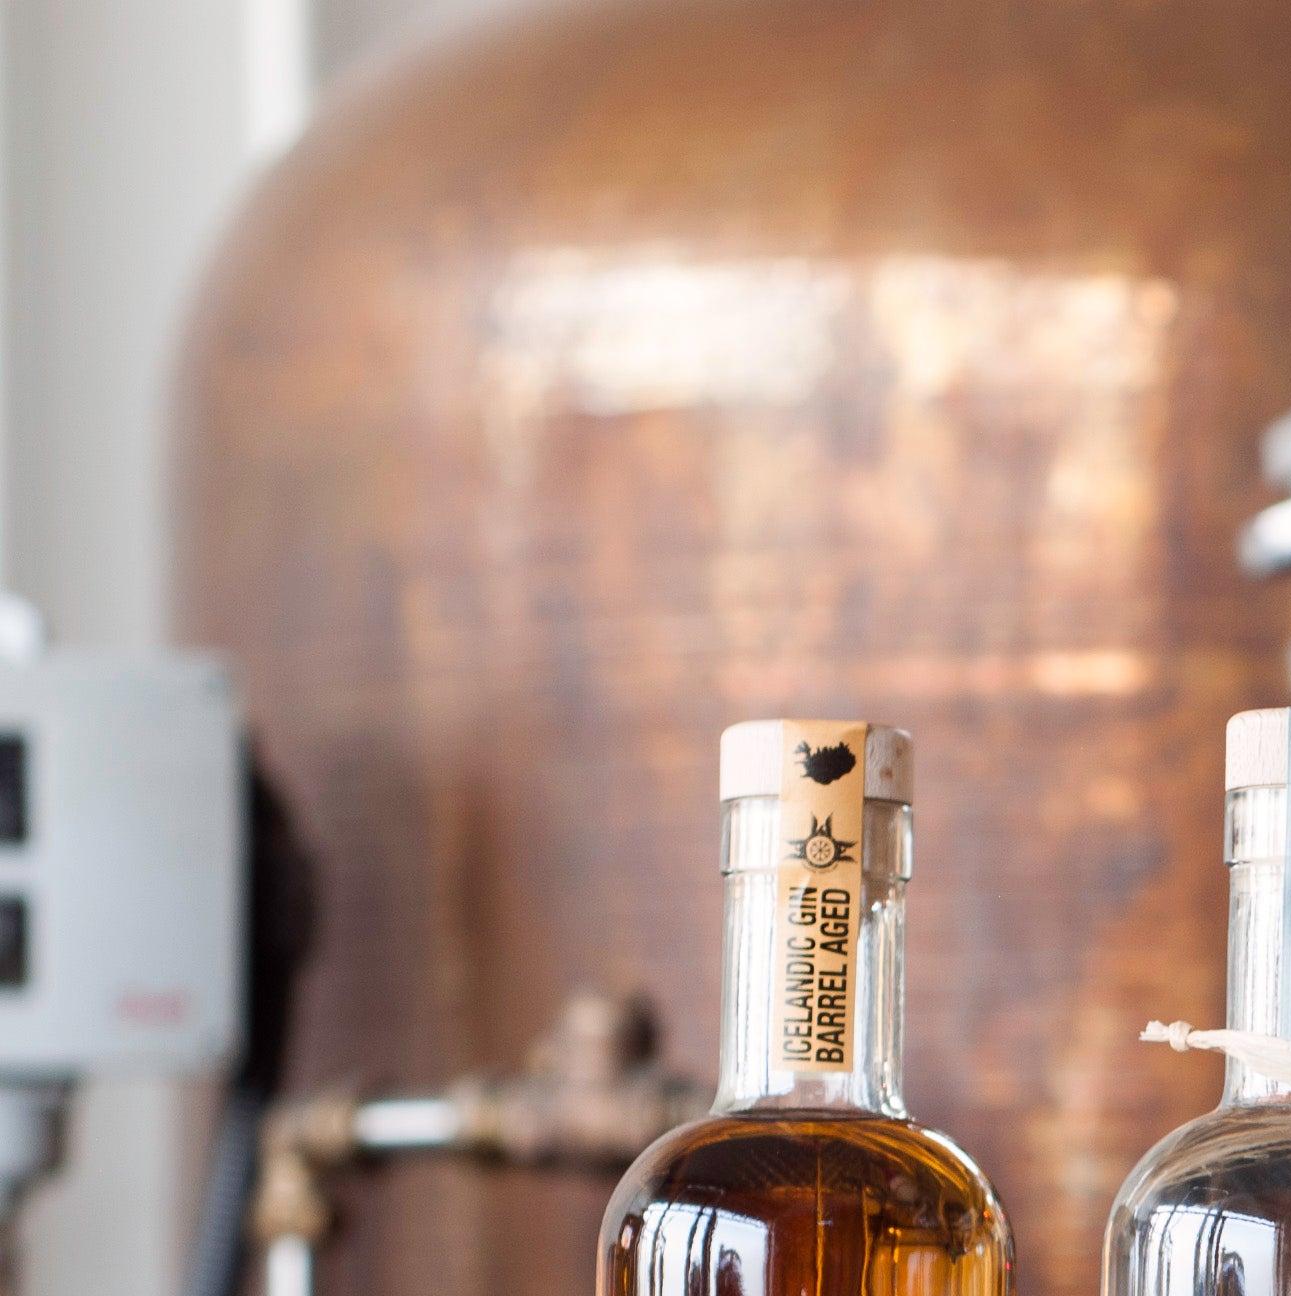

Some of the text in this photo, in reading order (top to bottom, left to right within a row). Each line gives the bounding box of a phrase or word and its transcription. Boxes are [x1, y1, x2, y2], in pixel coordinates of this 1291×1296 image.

[820, 888, 850, 956] AGED
[783, 886, 818, 1061] ICELANDIC GIN
[816, 964, 847, 1064] BARREL
